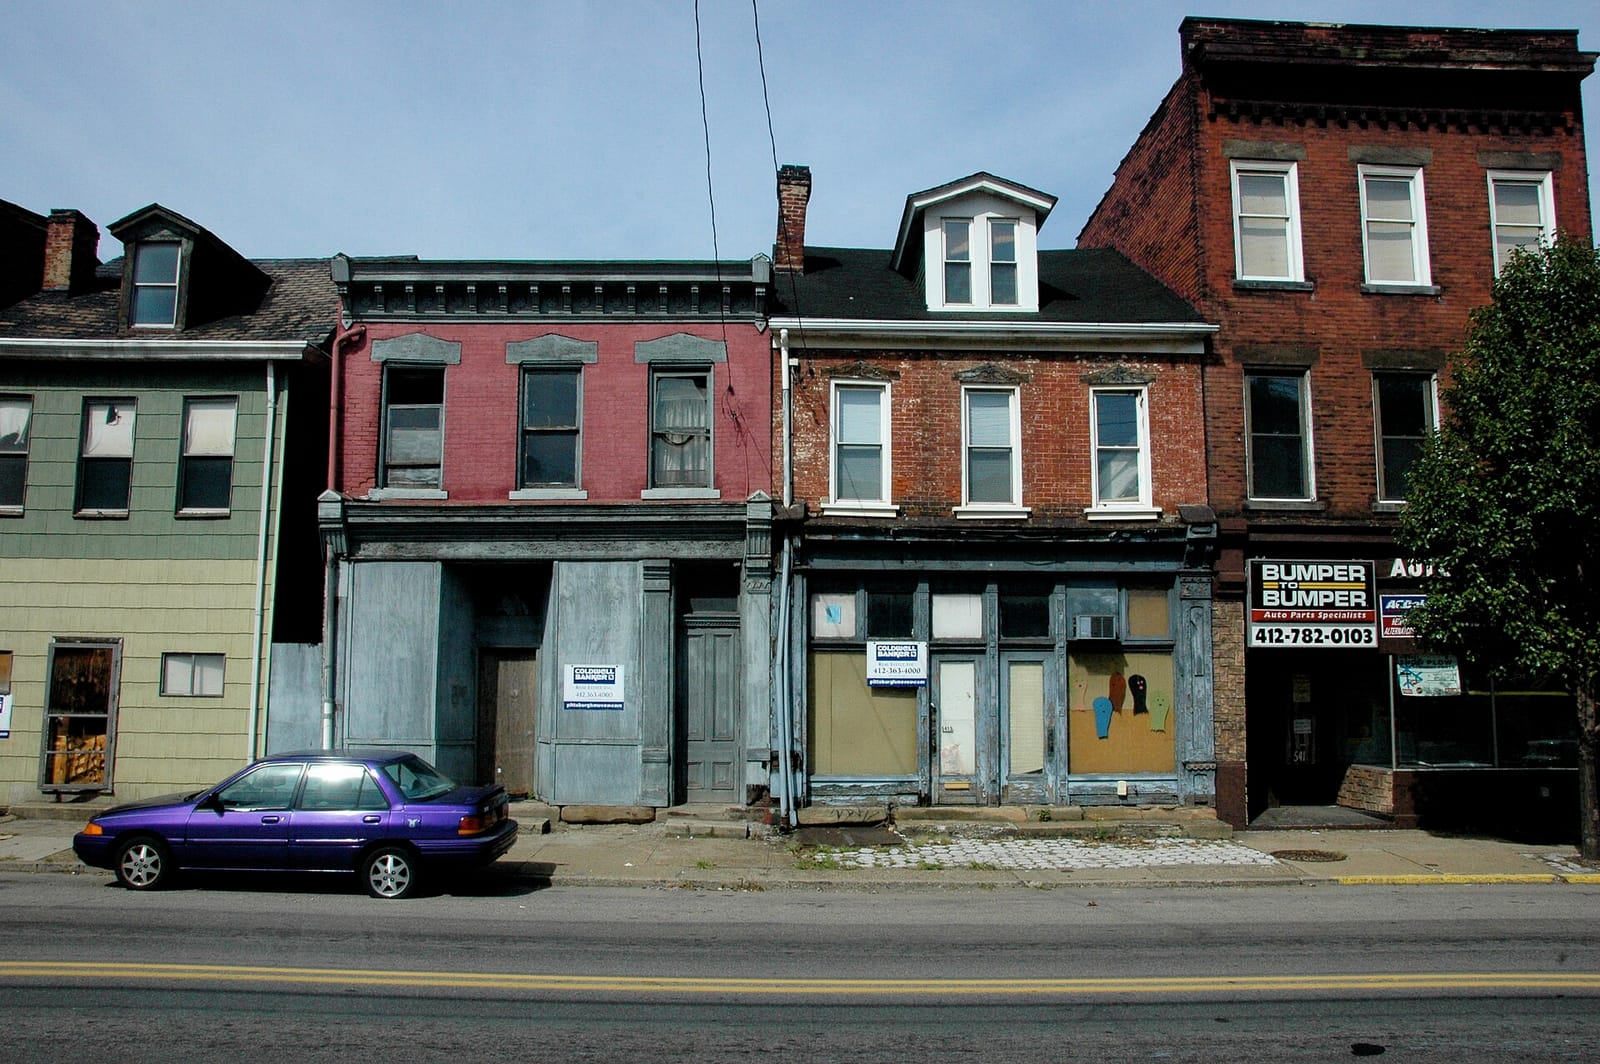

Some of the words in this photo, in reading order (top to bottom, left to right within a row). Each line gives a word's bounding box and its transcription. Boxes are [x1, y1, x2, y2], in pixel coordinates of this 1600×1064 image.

[1262, 564, 1366, 581] BUMPER
[1263, 590, 1367, 607] BUMPER
[1263, 611, 1288, 619] Auto
[1290, 611, 1315, 619] Parts
[1318, 611, 1367, 620] Specialists
[1255, 628, 1373, 644] 412-782-0103
